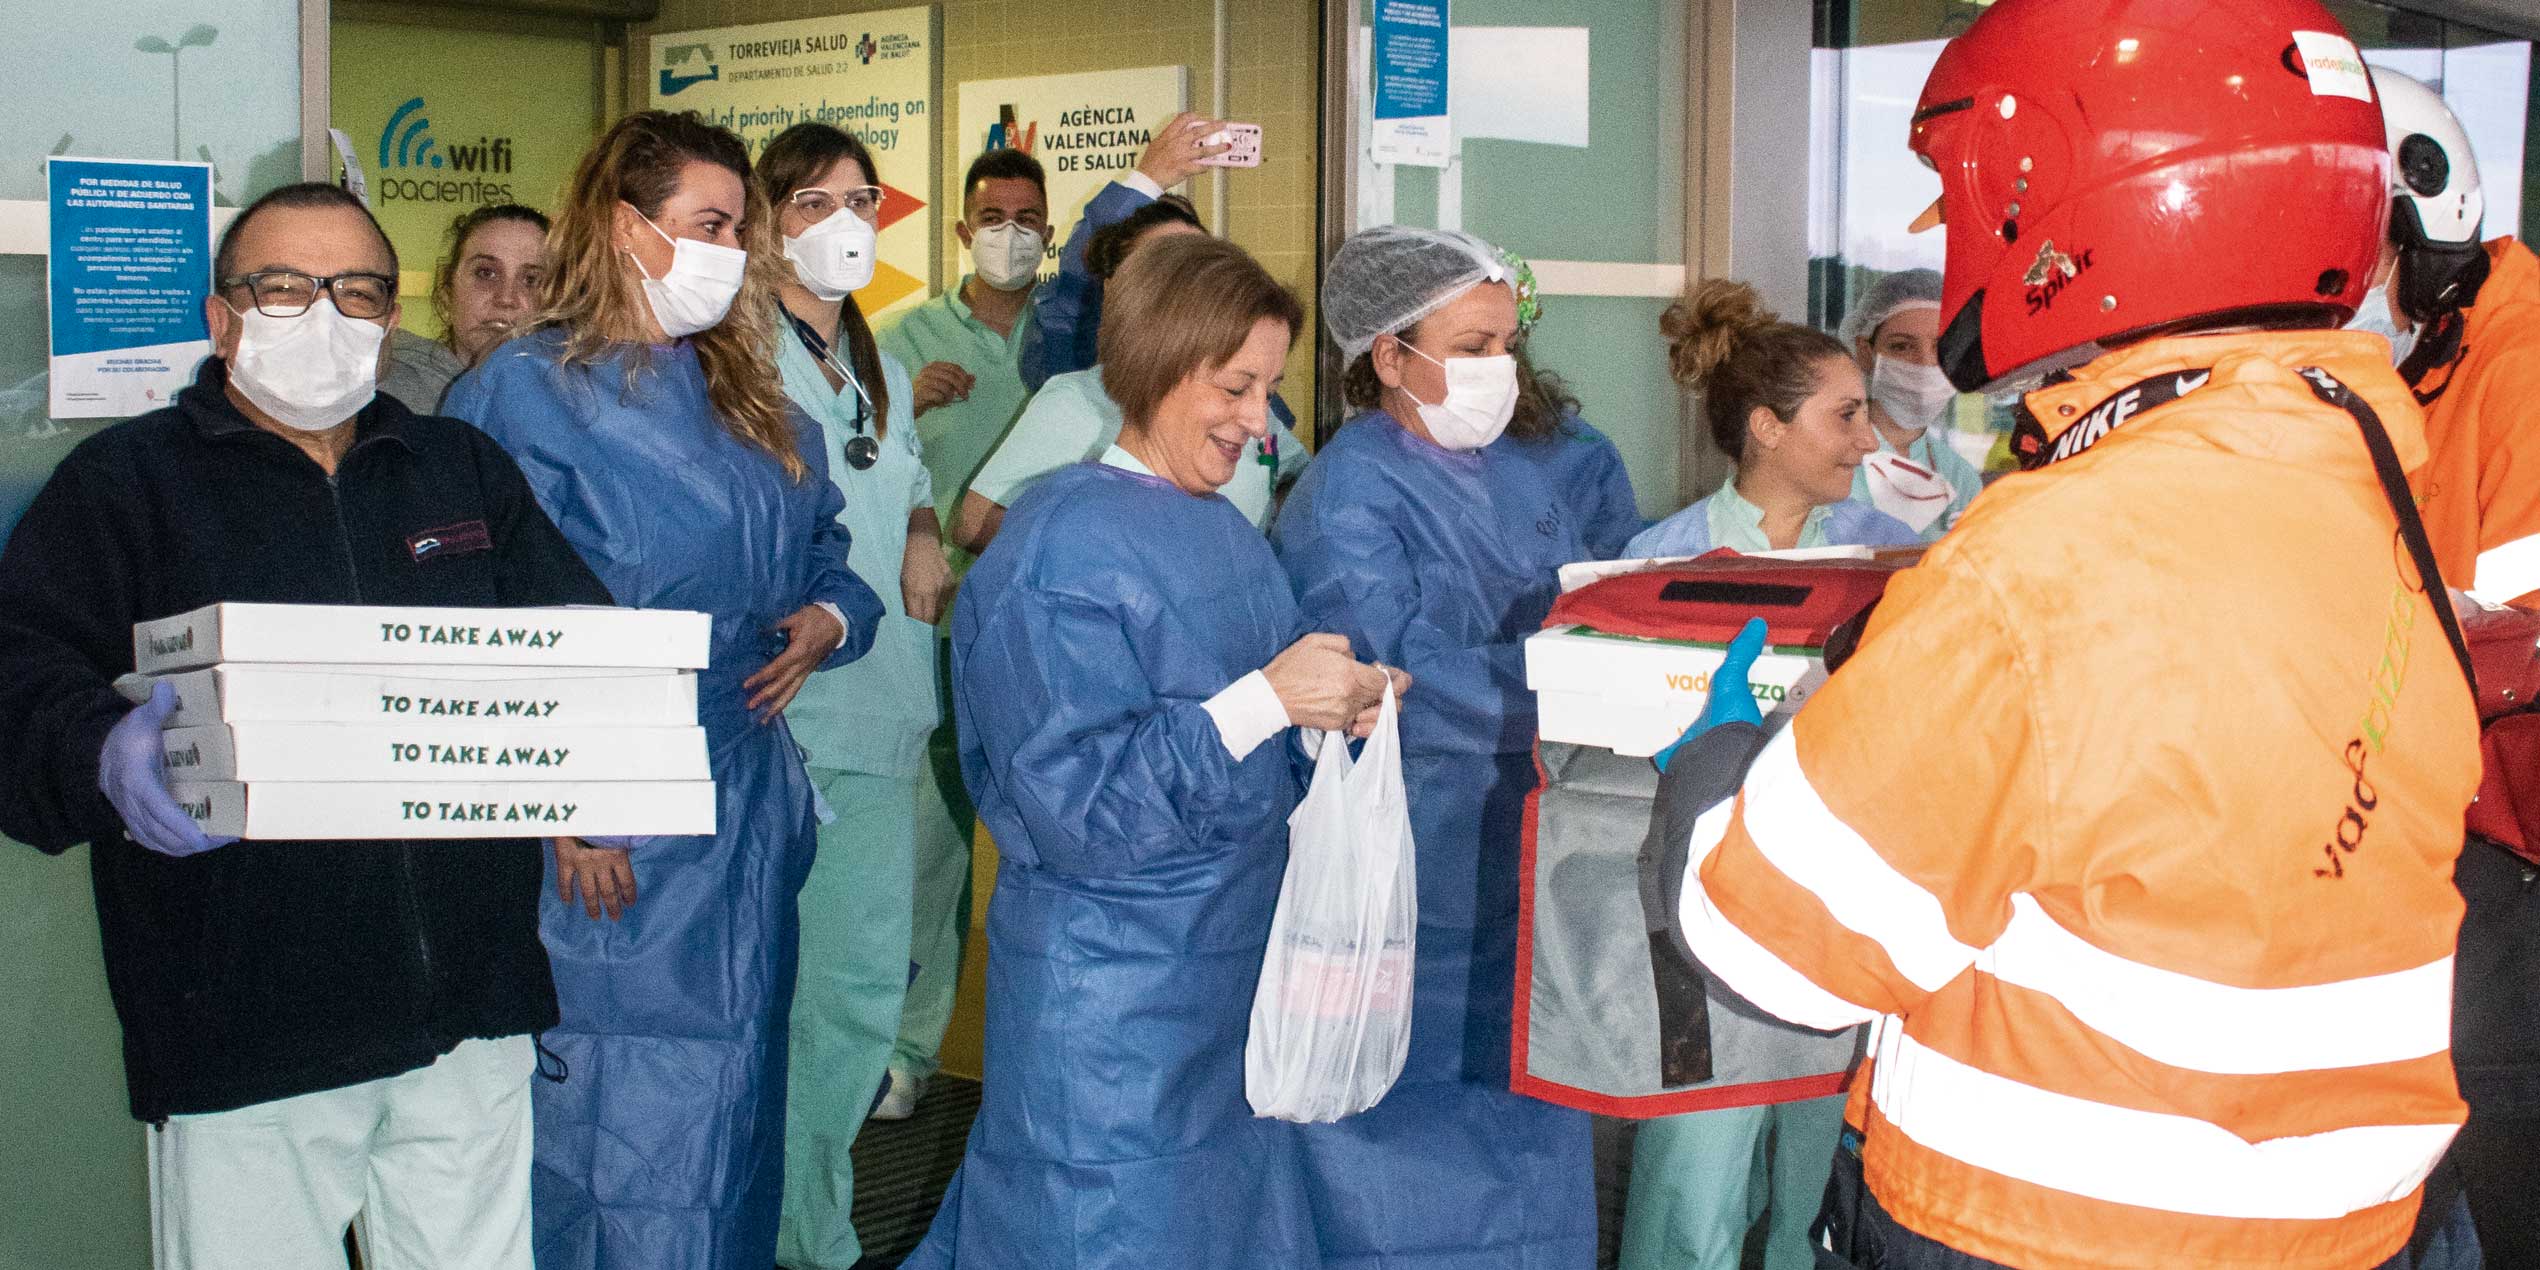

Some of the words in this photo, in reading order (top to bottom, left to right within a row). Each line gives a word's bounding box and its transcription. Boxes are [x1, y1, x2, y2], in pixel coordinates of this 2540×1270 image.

[729, 38, 802, 60] TORREVIEJA
[806, 34, 848, 53] SALUD
[729, 65, 792, 82] DEPARTAMENTO
[793, 65, 804, 78] DE
[806, 64, 834, 77] SALUD
[720, 105, 735, 128] of
[739, 104, 794, 132] priority
[800, 103, 811, 121] is
[816, 96, 899, 123] depending
[905, 99, 925, 116] on
[1060, 104, 1135, 127] AGÈNCIA
[1044, 129, 1151, 150] VALENCIANA
[449, 137, 512, 173] wifi
[1058, 155, 1079, 172] DE
[1085, 152, 1138, 170] SALUT
[80, 178, 98, 186] POR
[140, 180, 153, 188] DE
[155, 181, 182, 189] SALUD
[116, 190, 129, 198] DE
[381, 176, 515, 208] pacientes
[66, 199, 84, 207] LAS
[2051, 389, 2141, 464] NIKE
[381, 623, 411, 642] TO
[419, 625, 480, 645] TAKE
[486, 627, 564, 649] AWAY
[382, 695, 412, 713] TO
[419, 697, 480, 716] TAKE
[484, 700, 560, 718] AWAY
[392, 743, 421, 762] TO
[428, 744, 489, 765] TAKE
[495, 747, 571, 767] AWAY
[402, 801, 432, 820] TO
[438, 802, 498, 822] TAKE
[504, 803, 578, 823] AWAY
